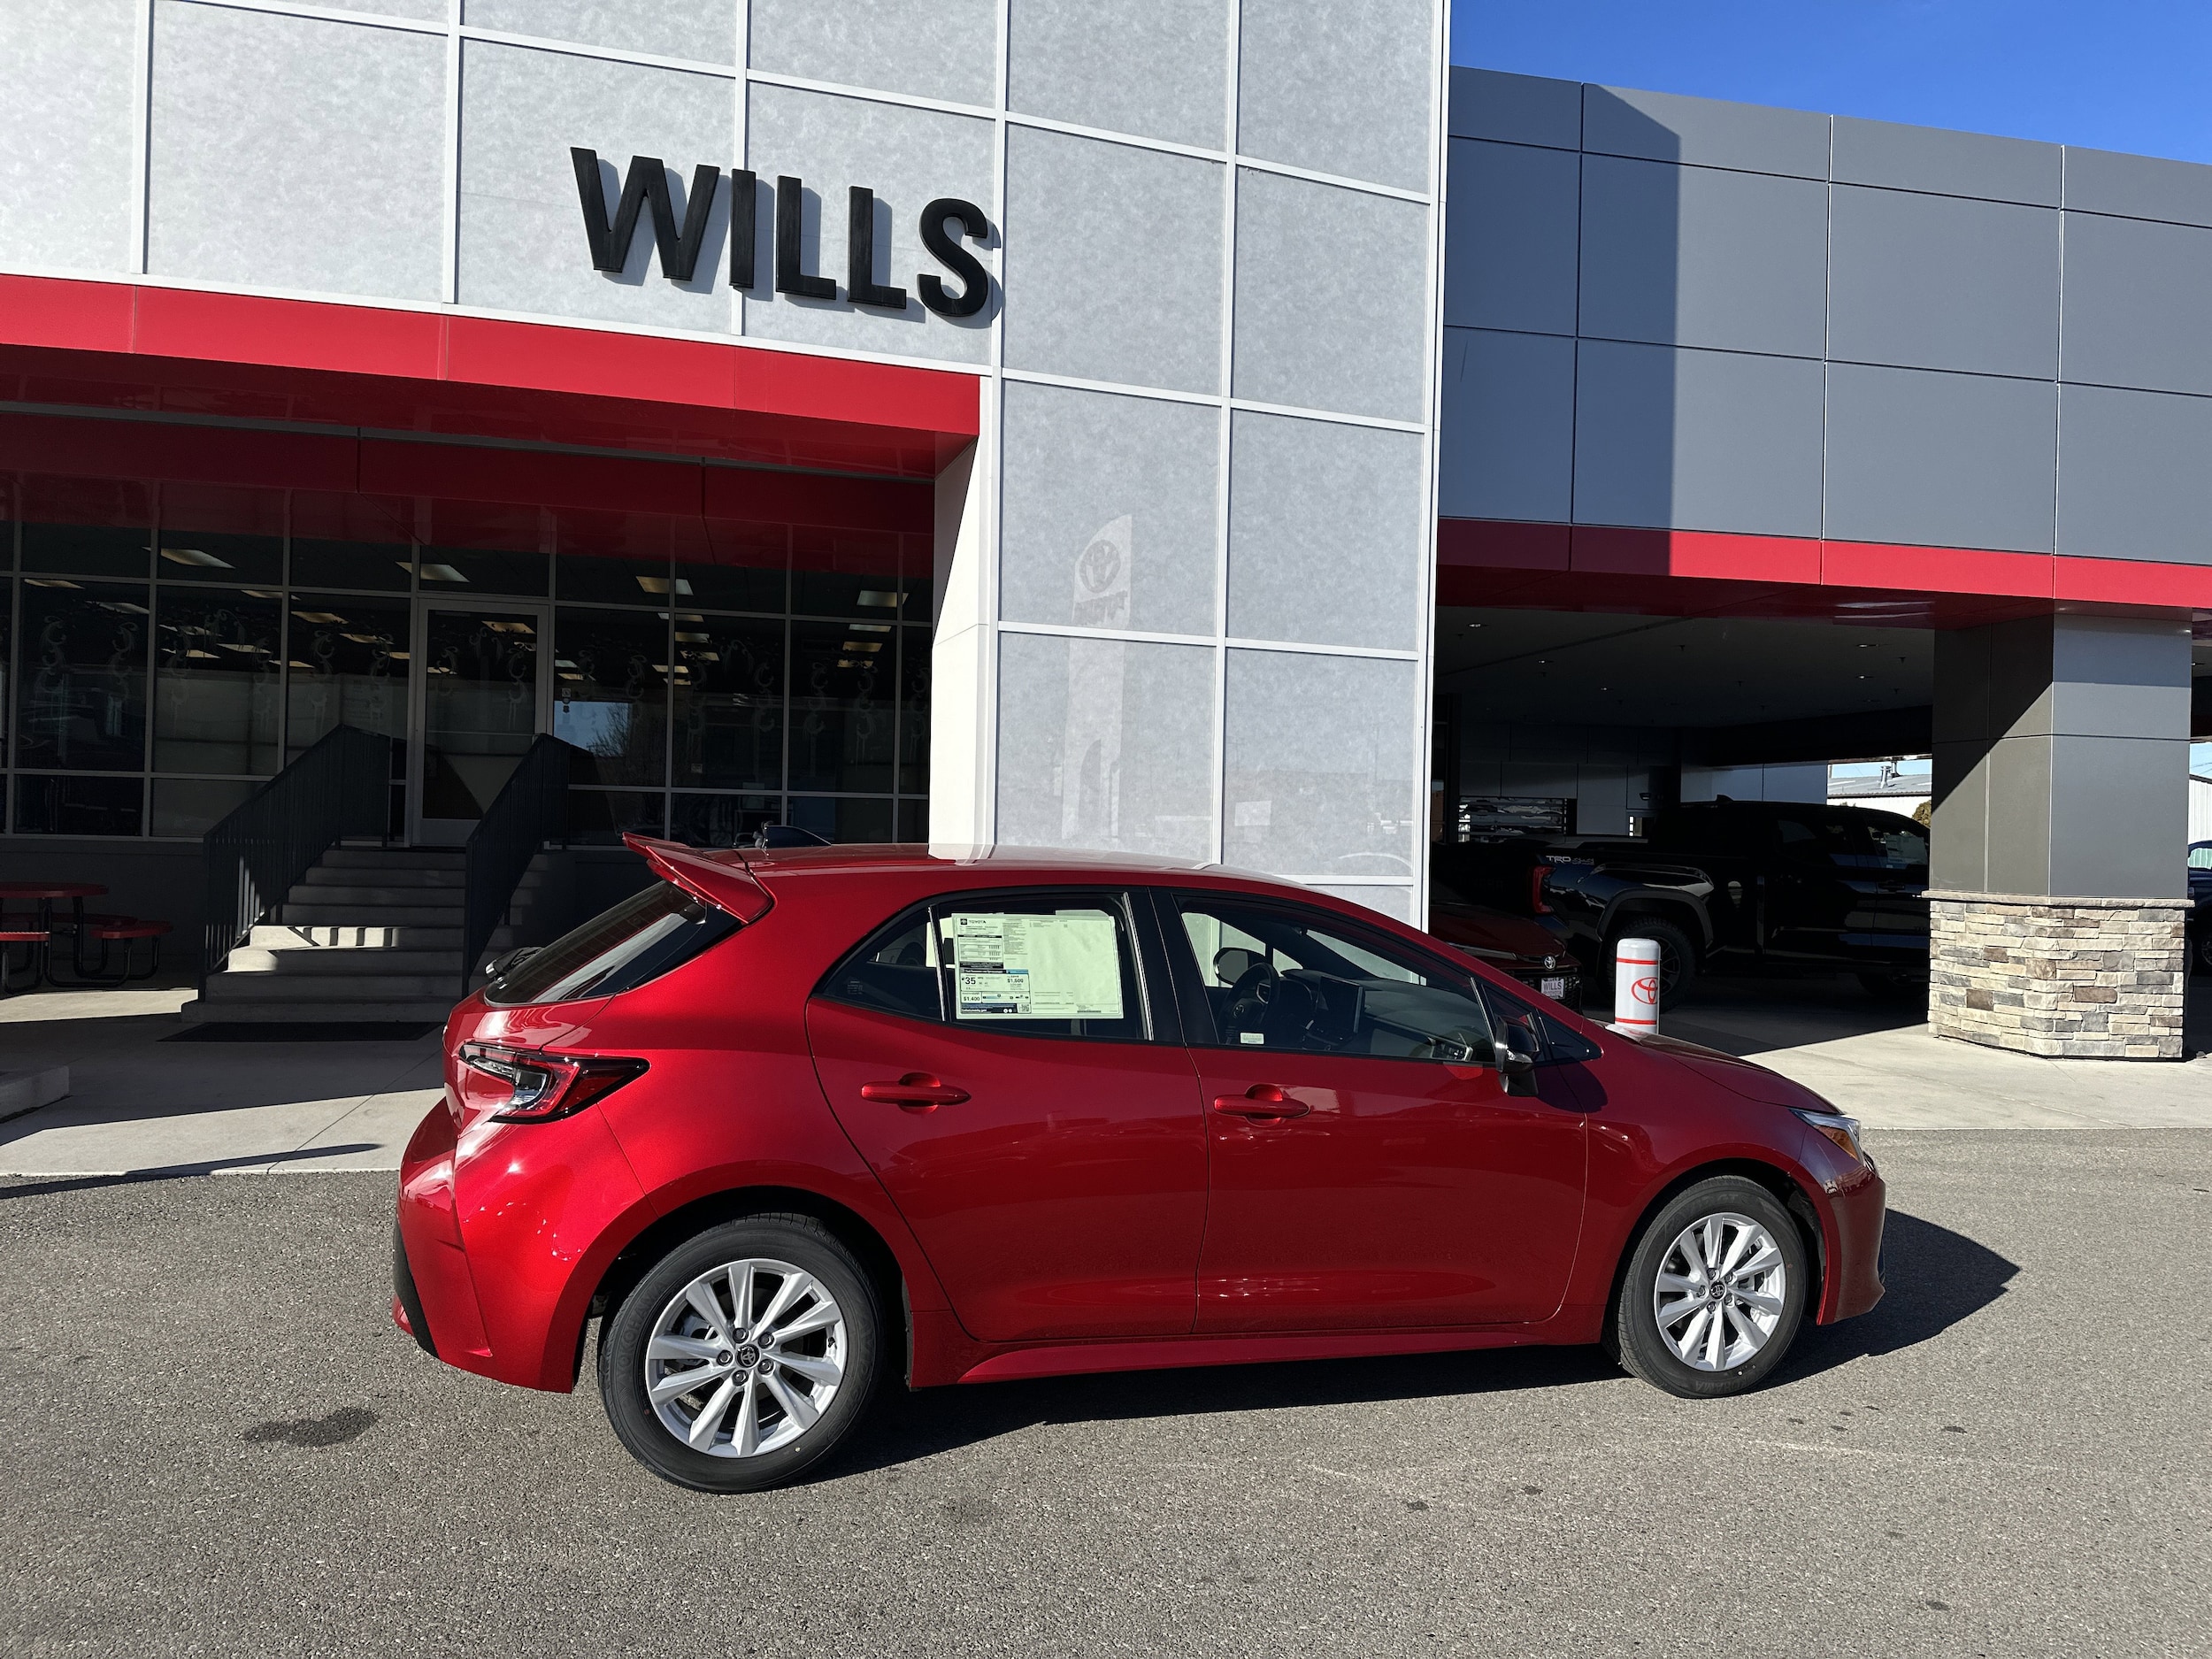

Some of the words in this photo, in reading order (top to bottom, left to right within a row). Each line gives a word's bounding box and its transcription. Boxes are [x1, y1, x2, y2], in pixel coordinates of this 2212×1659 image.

[570, 146, 988, 318] WILLS
[1546, 855, 1571, 864] TRD
[1543, 981, 1562, 991] WILLS
[616, 1280, 668, 1387] YOKOHAMA
